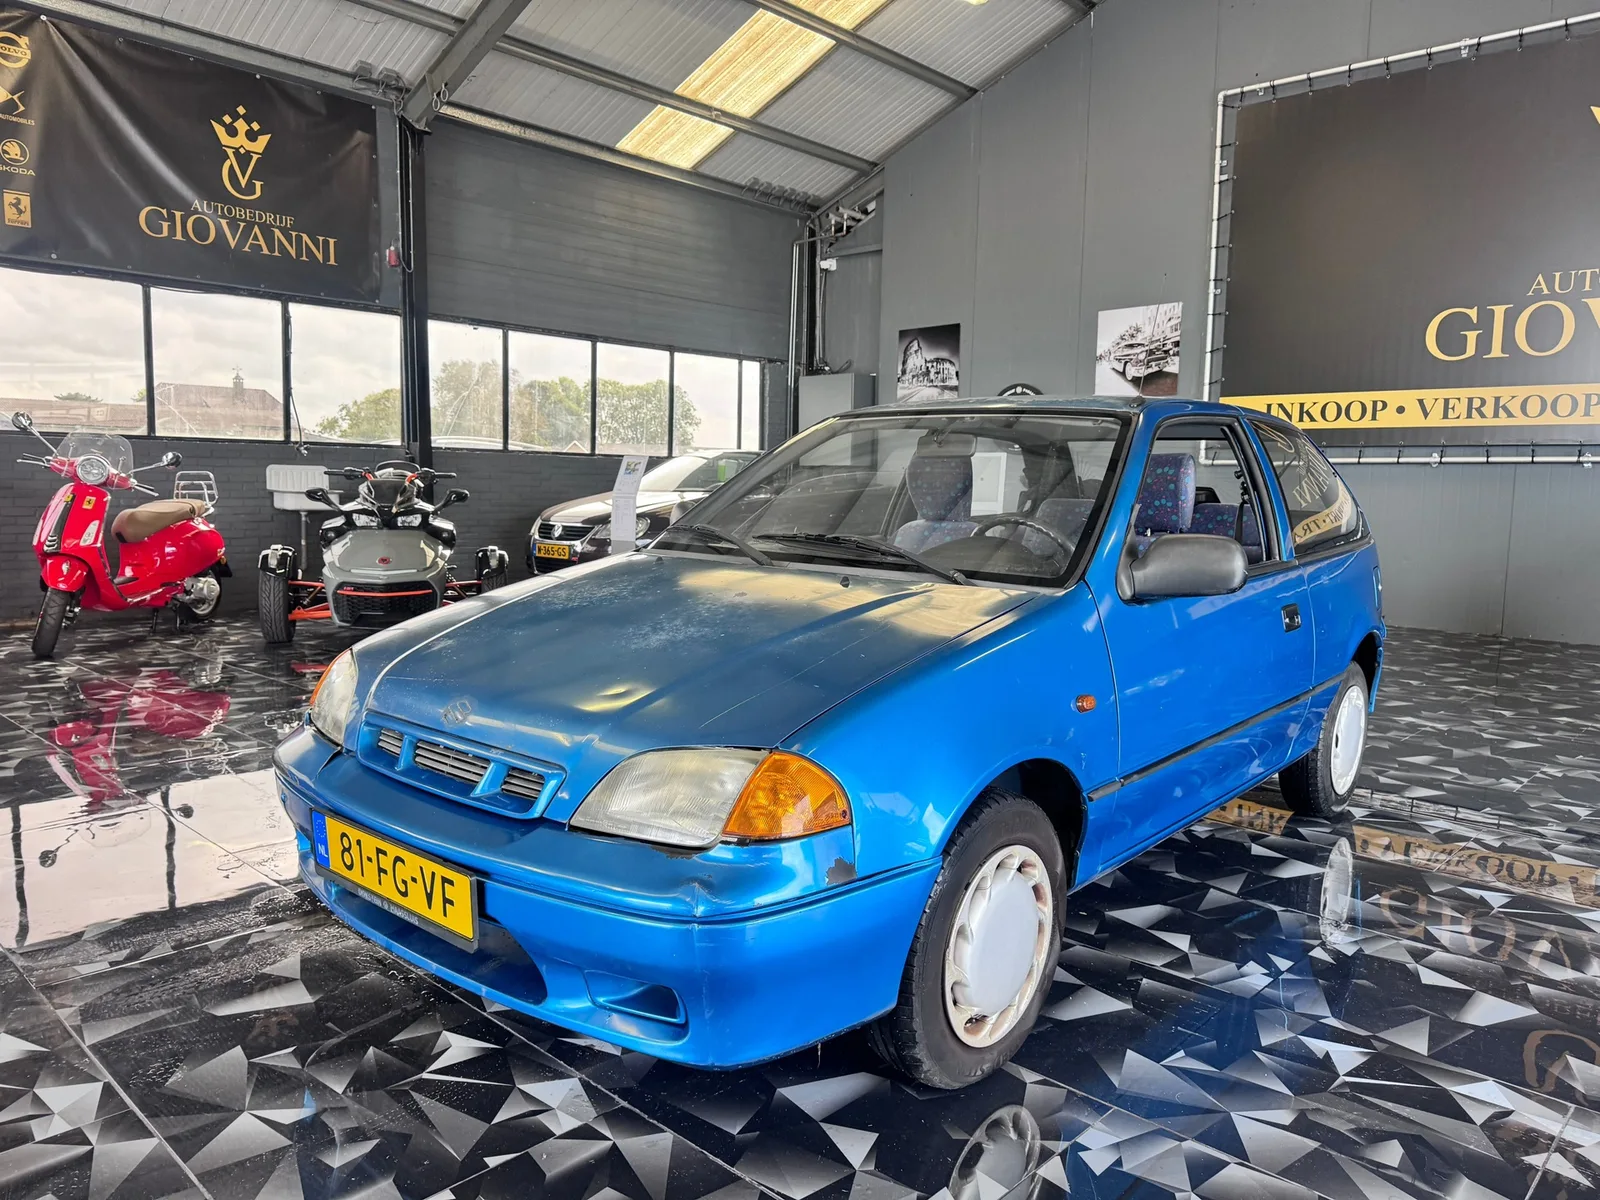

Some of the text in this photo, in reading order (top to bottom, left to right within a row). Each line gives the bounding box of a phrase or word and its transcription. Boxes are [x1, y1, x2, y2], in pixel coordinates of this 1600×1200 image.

[191, 199, 295, 229] AUTOBEDRIJF
[138, 205, 339, 266] GIOVANNI
[1526, 267, 1600, 297] AUT
[1265, 392, 1600, 424] INKOOP VERKOOP
[318, 844, 329, 858] NL
[340, 831, 455, 918] 81-FG-VF
